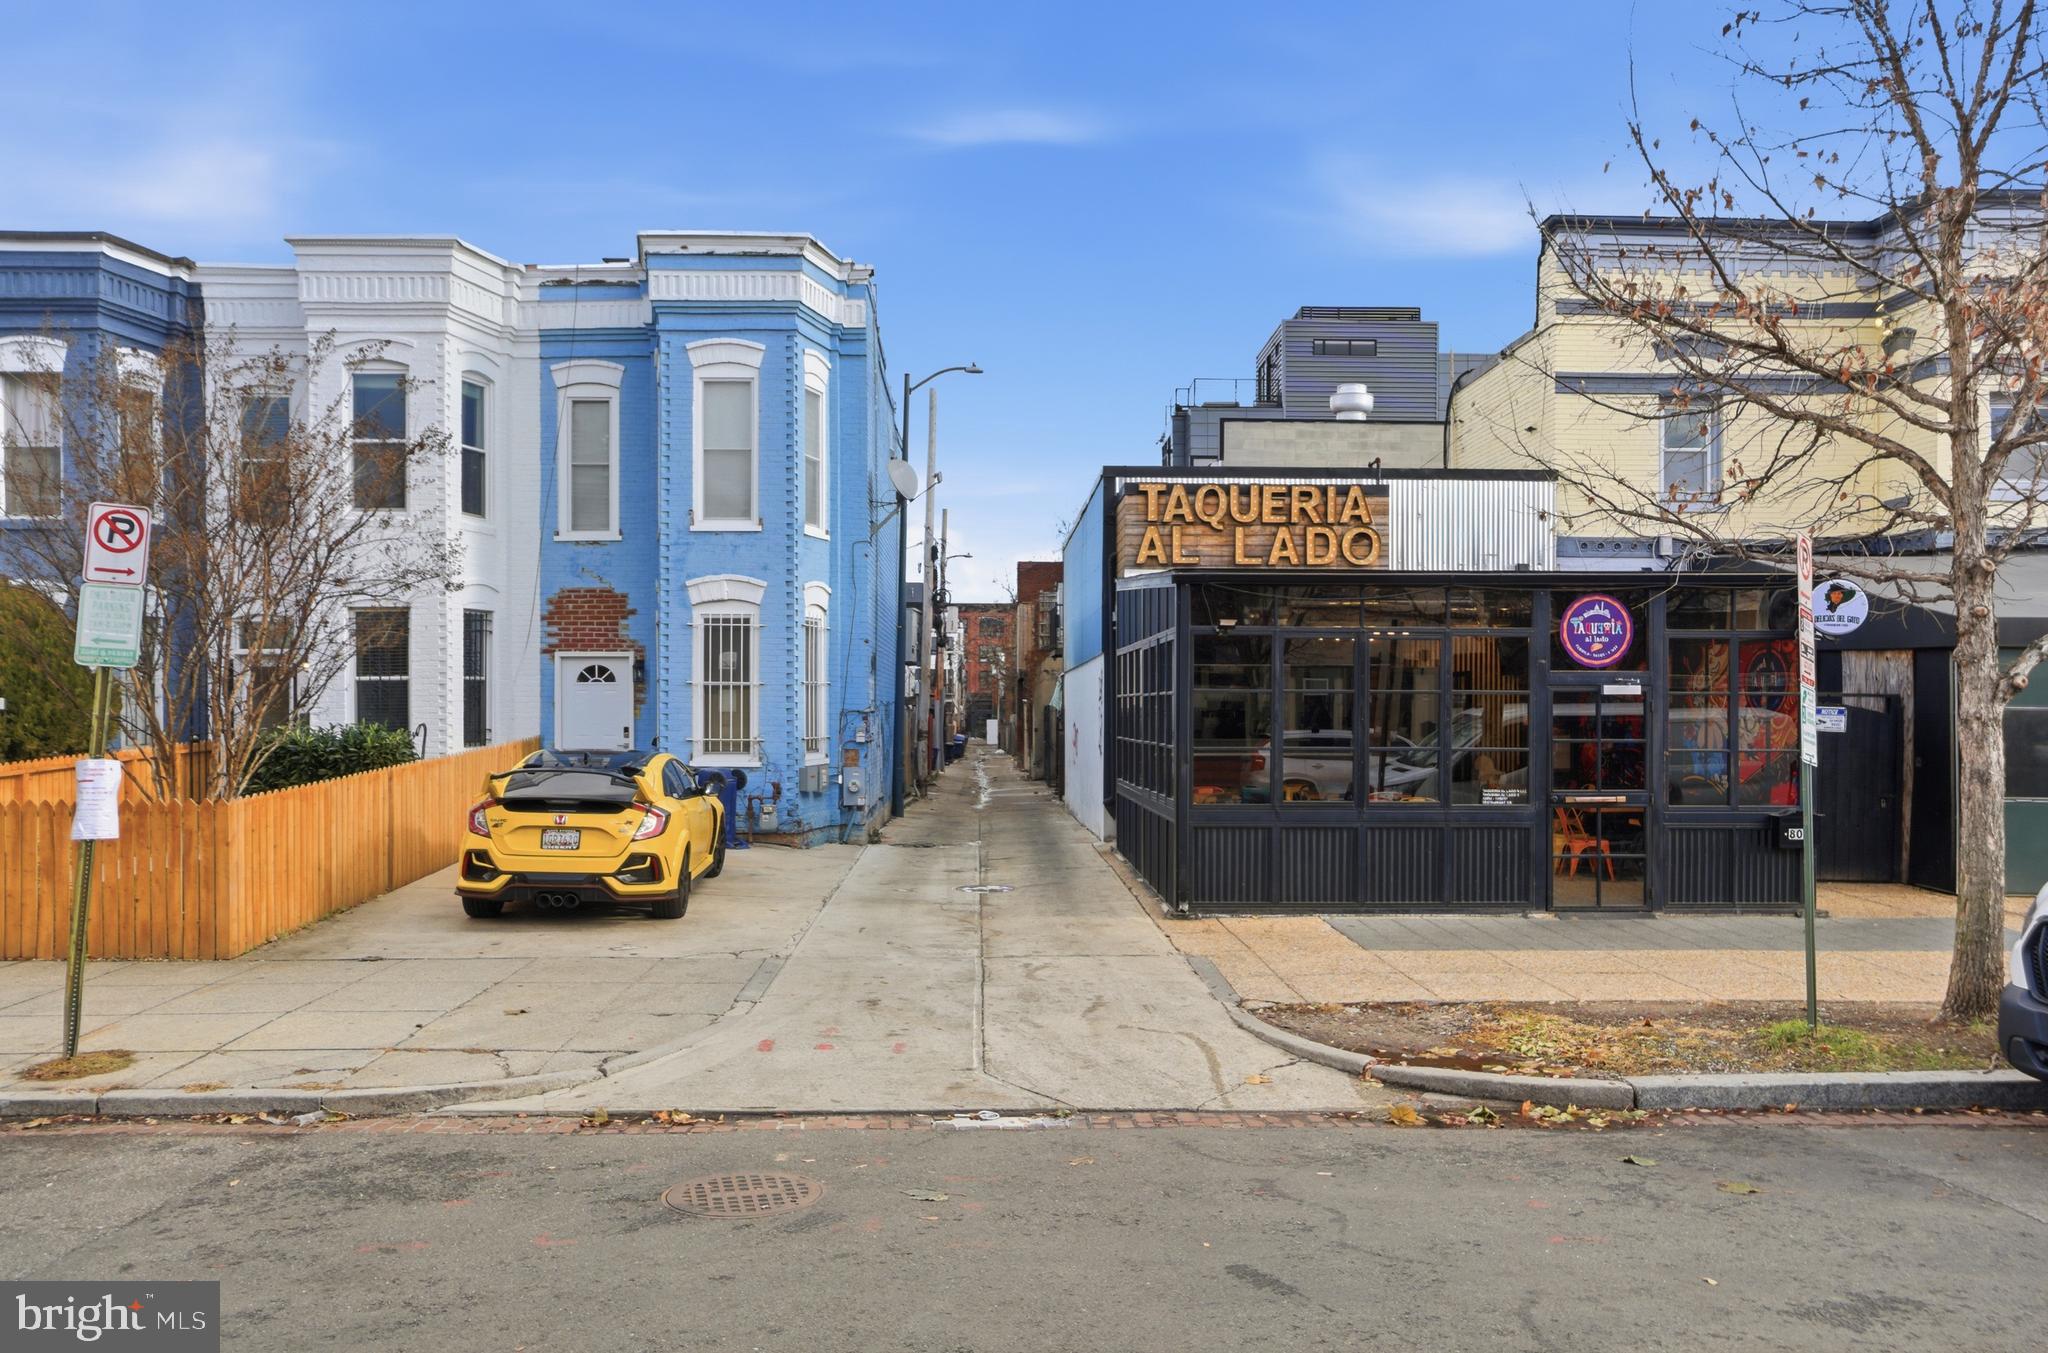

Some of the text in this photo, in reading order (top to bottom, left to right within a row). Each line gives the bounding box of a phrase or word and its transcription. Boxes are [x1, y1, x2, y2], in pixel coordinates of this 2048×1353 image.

[1138, 484, 1373, 530] TAQUERIA
[1136, 526, 1381, 566] AL LADO
[1837, 615, 1846, 623] DEL
[1847, 615, 1861, 625] GATO
